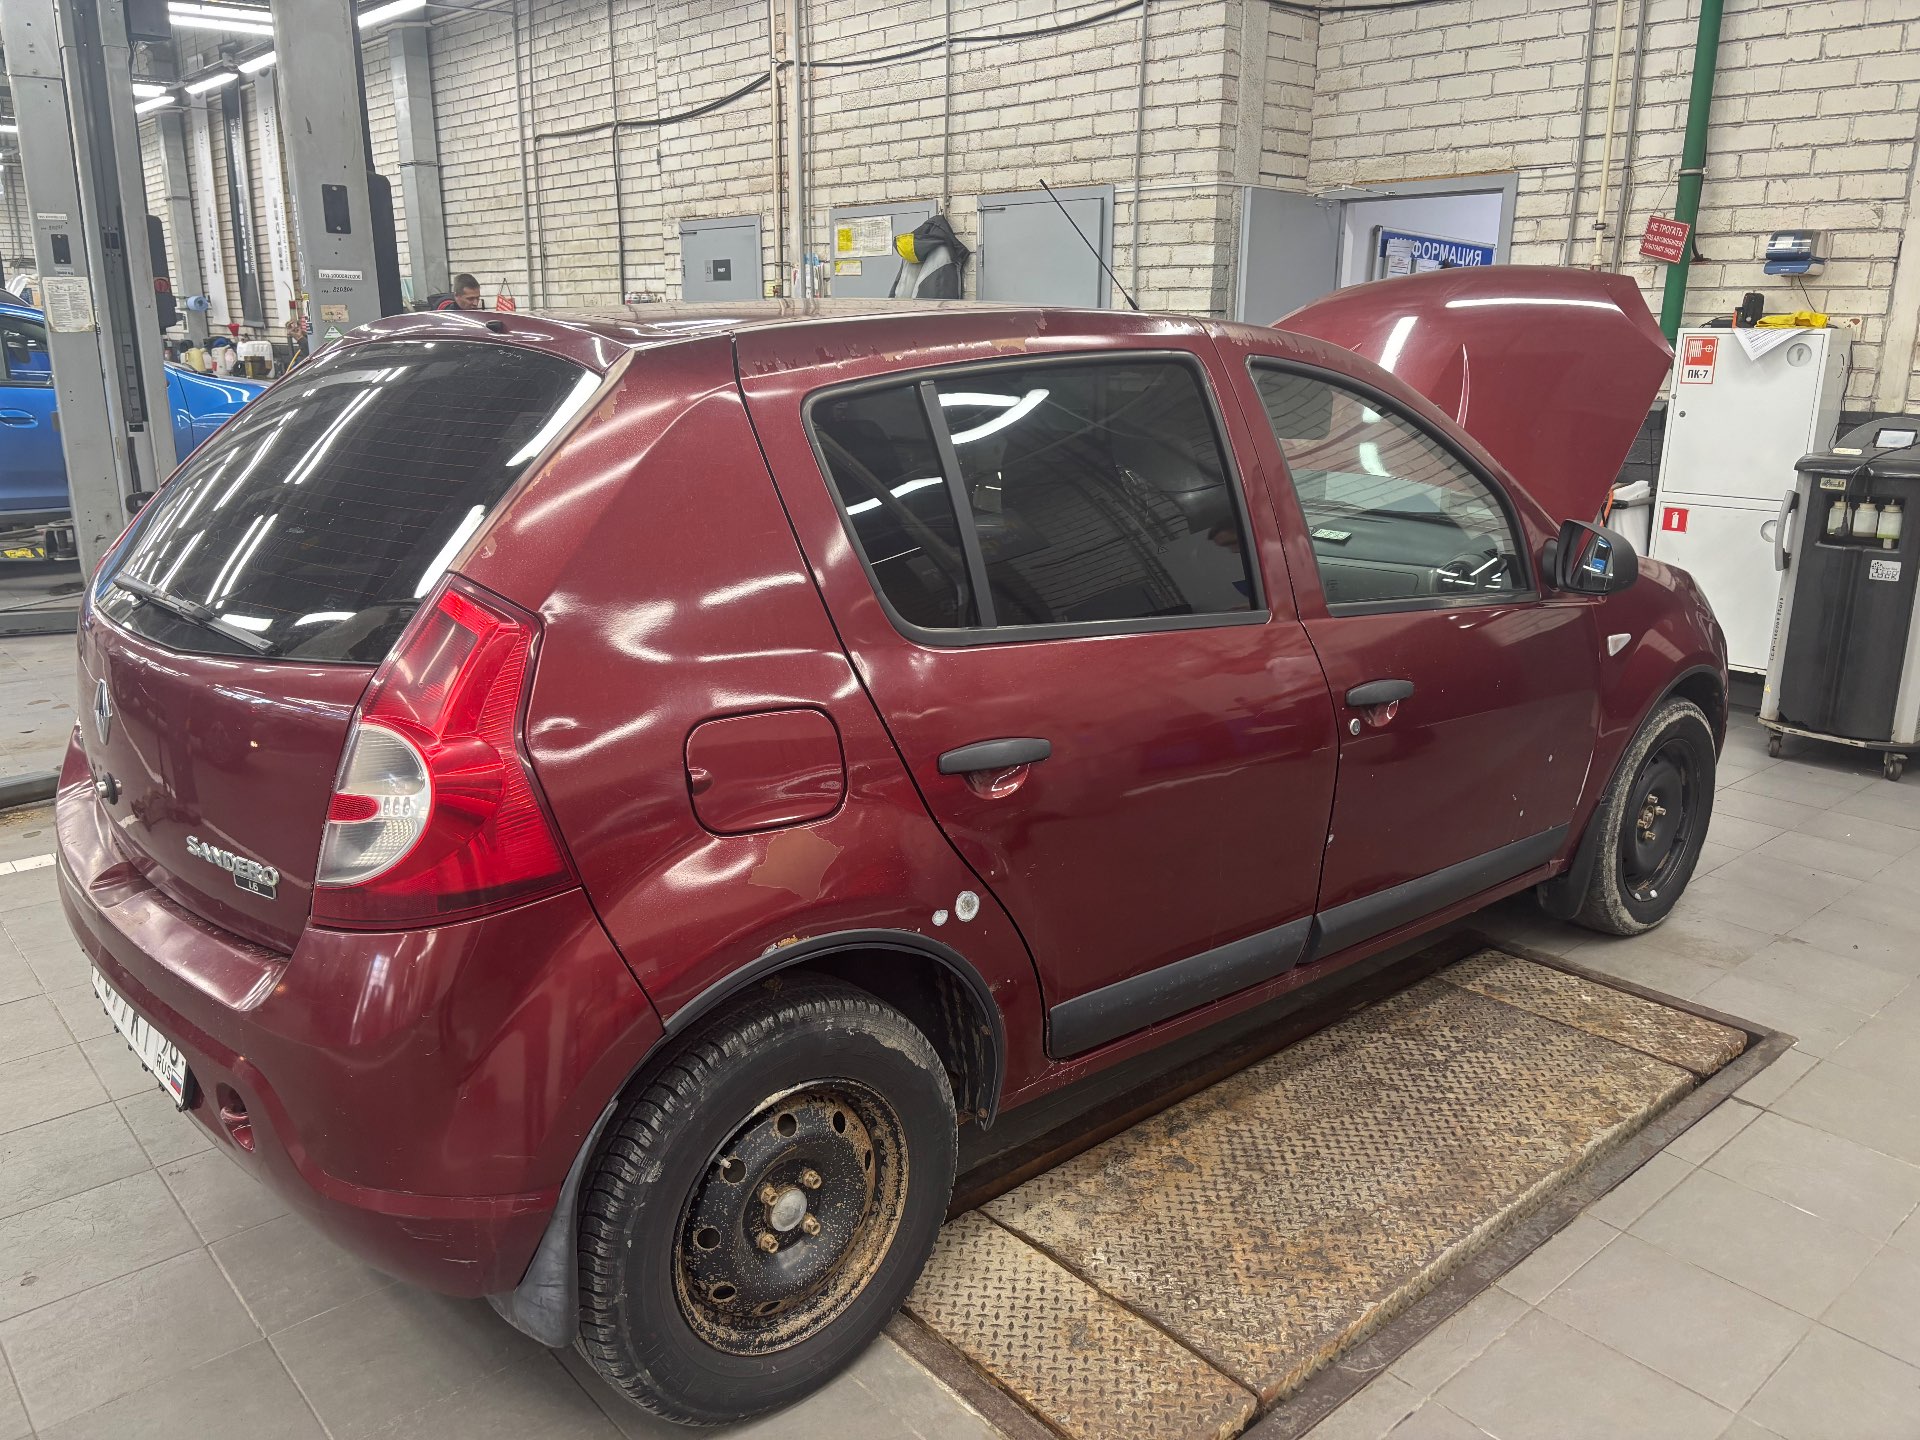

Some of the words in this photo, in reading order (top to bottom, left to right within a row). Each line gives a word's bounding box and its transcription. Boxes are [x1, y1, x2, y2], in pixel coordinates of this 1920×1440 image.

[1651, 222, 1659, 232] НЕ
[1659, 224, 1683, 237] ТРОГАТЬ
[1394, 237, 1482, 267] ФОРМАЦИЯ
[1687, 369, 1709, 379] ПК-7
[186, 835, 280, 886] SANDERO
[248, 881, 259, 892] 1.6
[157, 1053, 171, 1081] RUS
